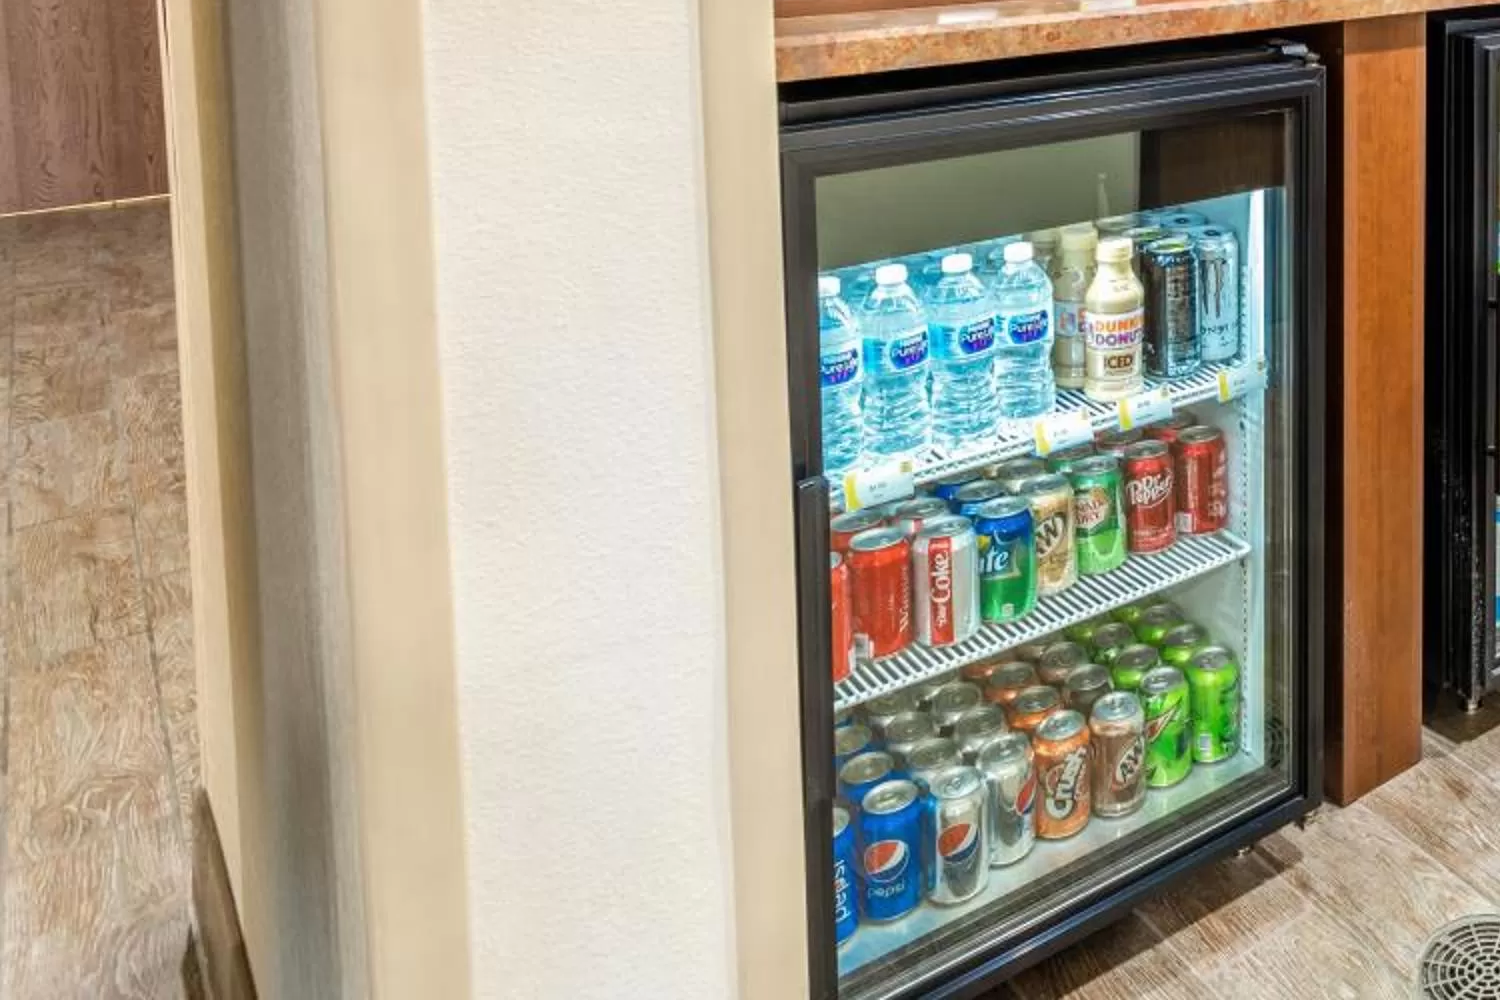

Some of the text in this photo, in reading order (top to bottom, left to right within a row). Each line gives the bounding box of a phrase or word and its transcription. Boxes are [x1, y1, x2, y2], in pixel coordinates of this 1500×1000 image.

[1095, 317, 1143, 331] DUNK
[1104, 354, 1133, 369] ICED
[930, 553, 953, 603] Coke
[867, 880, 906, 899] pepsi
